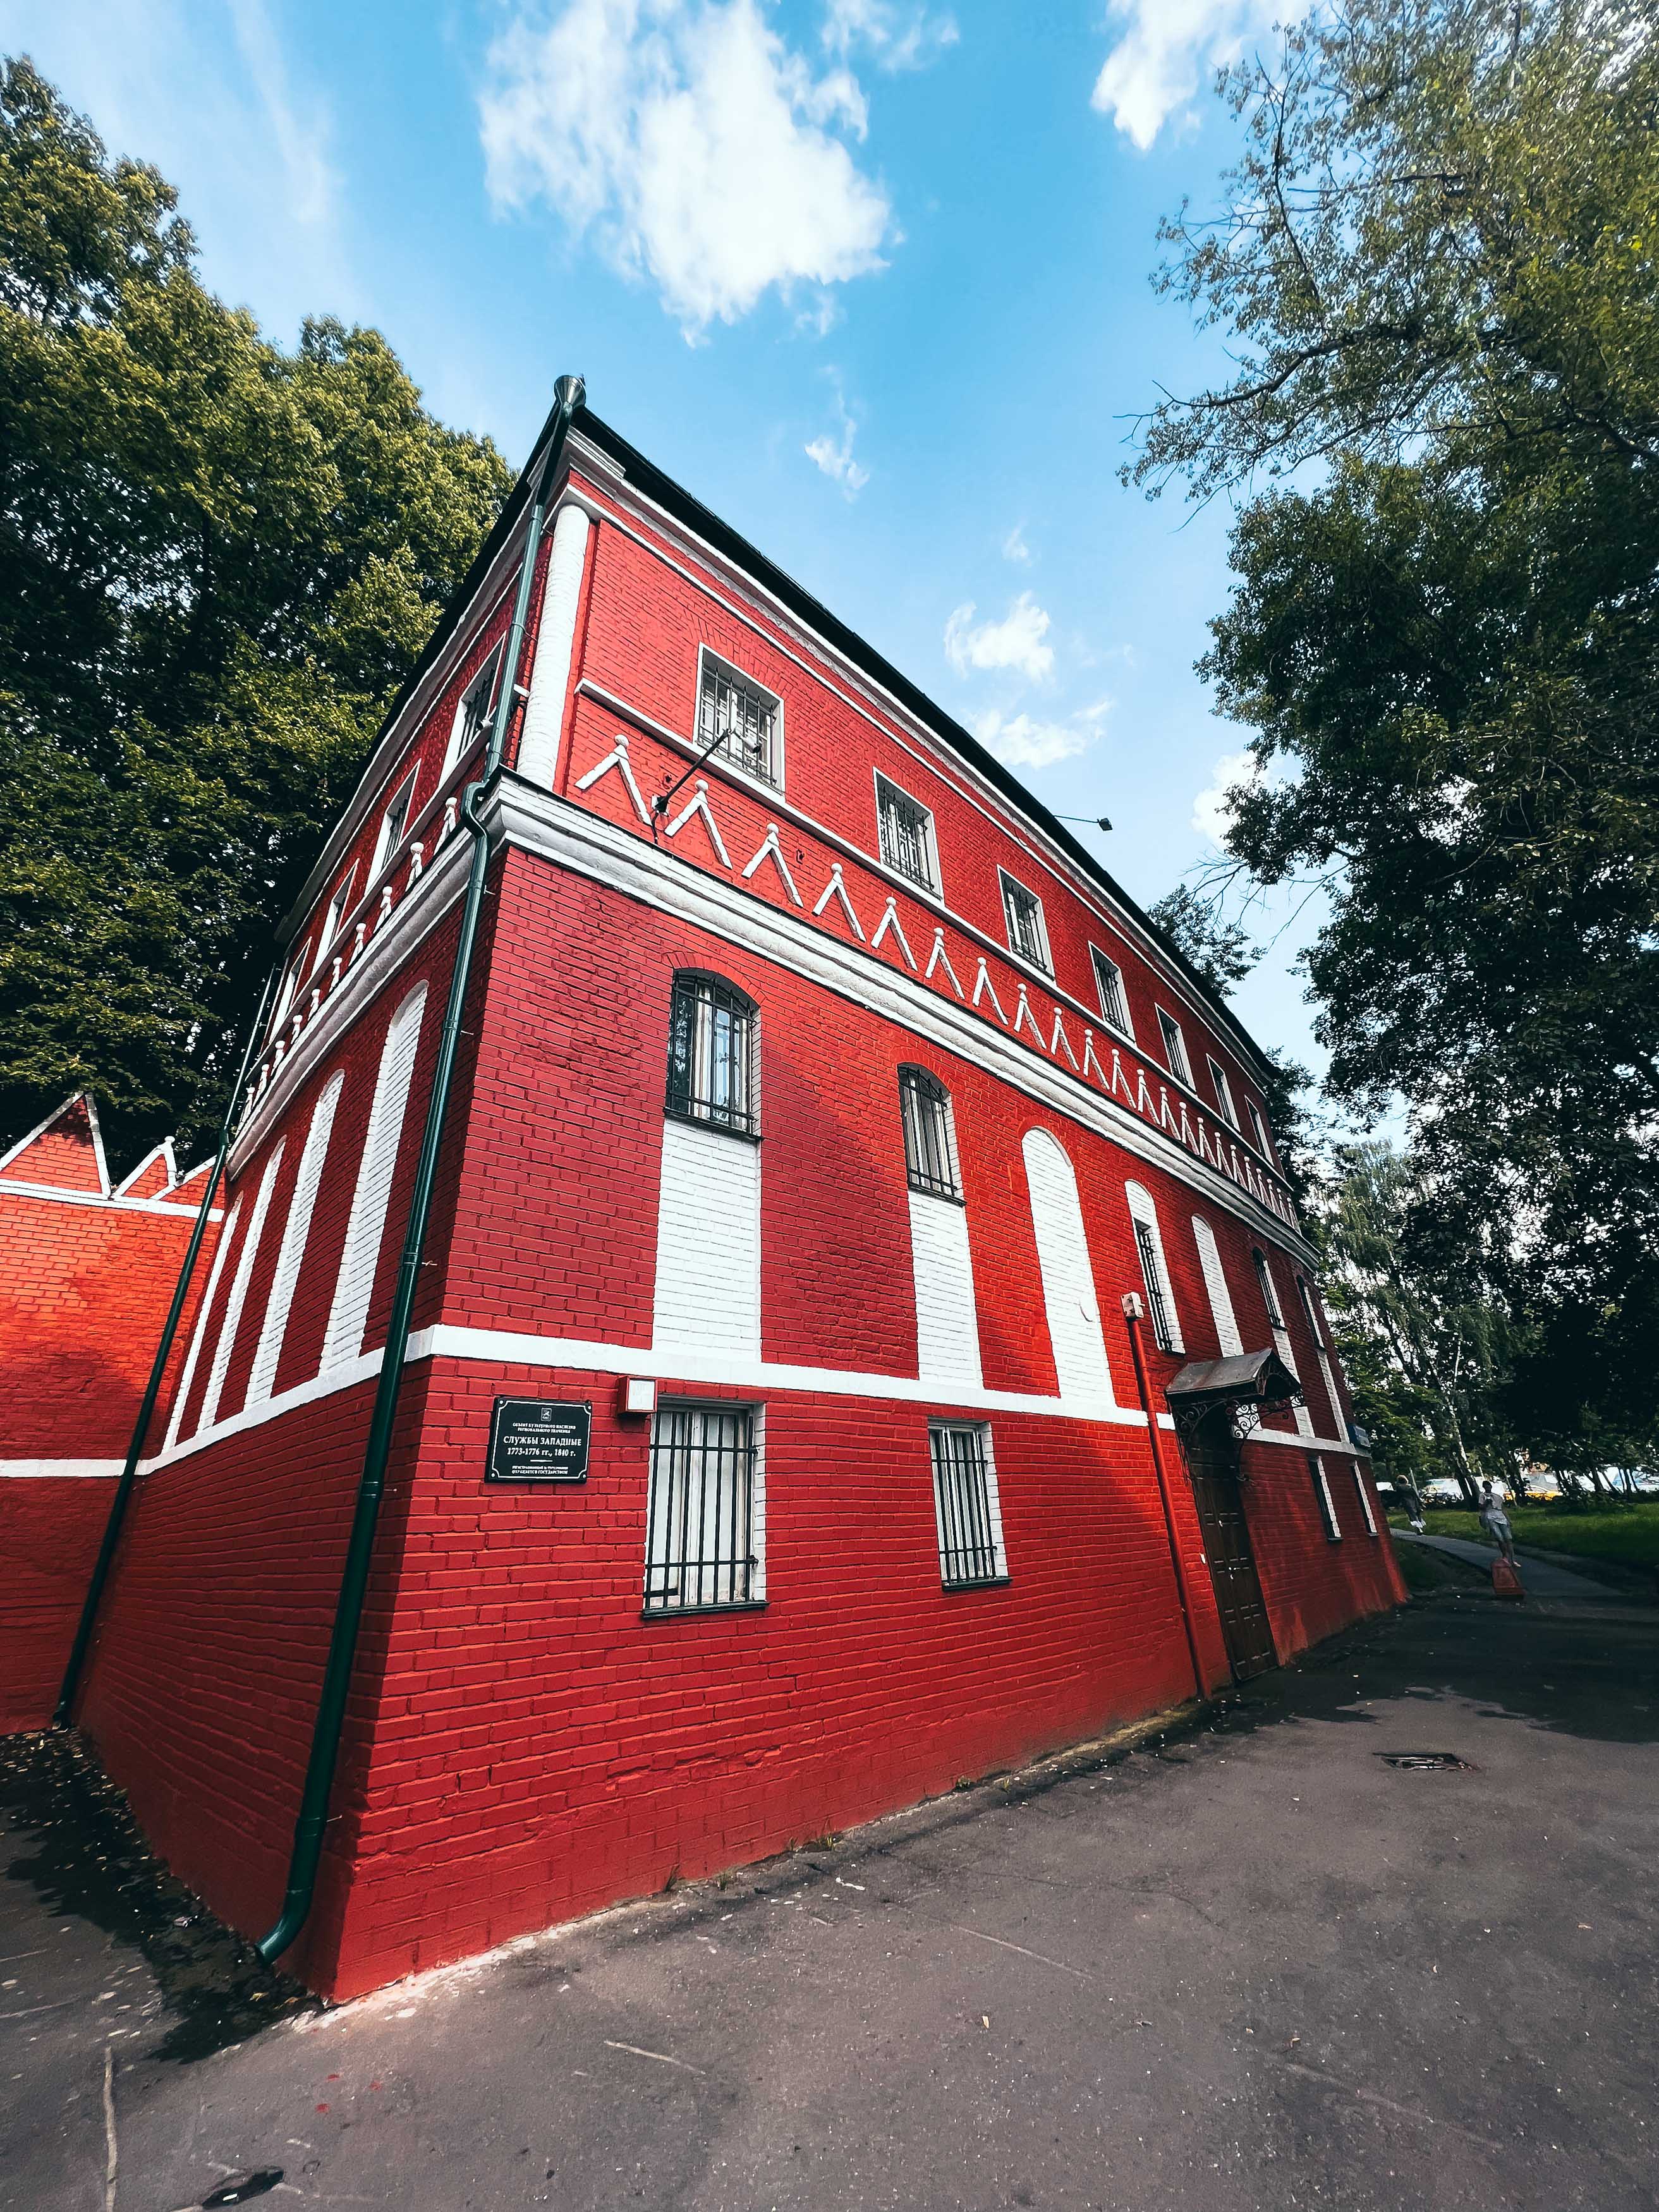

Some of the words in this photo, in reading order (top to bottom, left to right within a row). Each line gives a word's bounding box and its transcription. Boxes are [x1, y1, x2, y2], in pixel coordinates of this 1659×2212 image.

[503, 1435, 538, 1445] СЛУЖБЫ
[540, 1437, 582, 1447] ЗАПАДНЫЕ
[507, 1447, 540, 1455] 1773-1776
[554, 1449, 569, 1457] 1840
